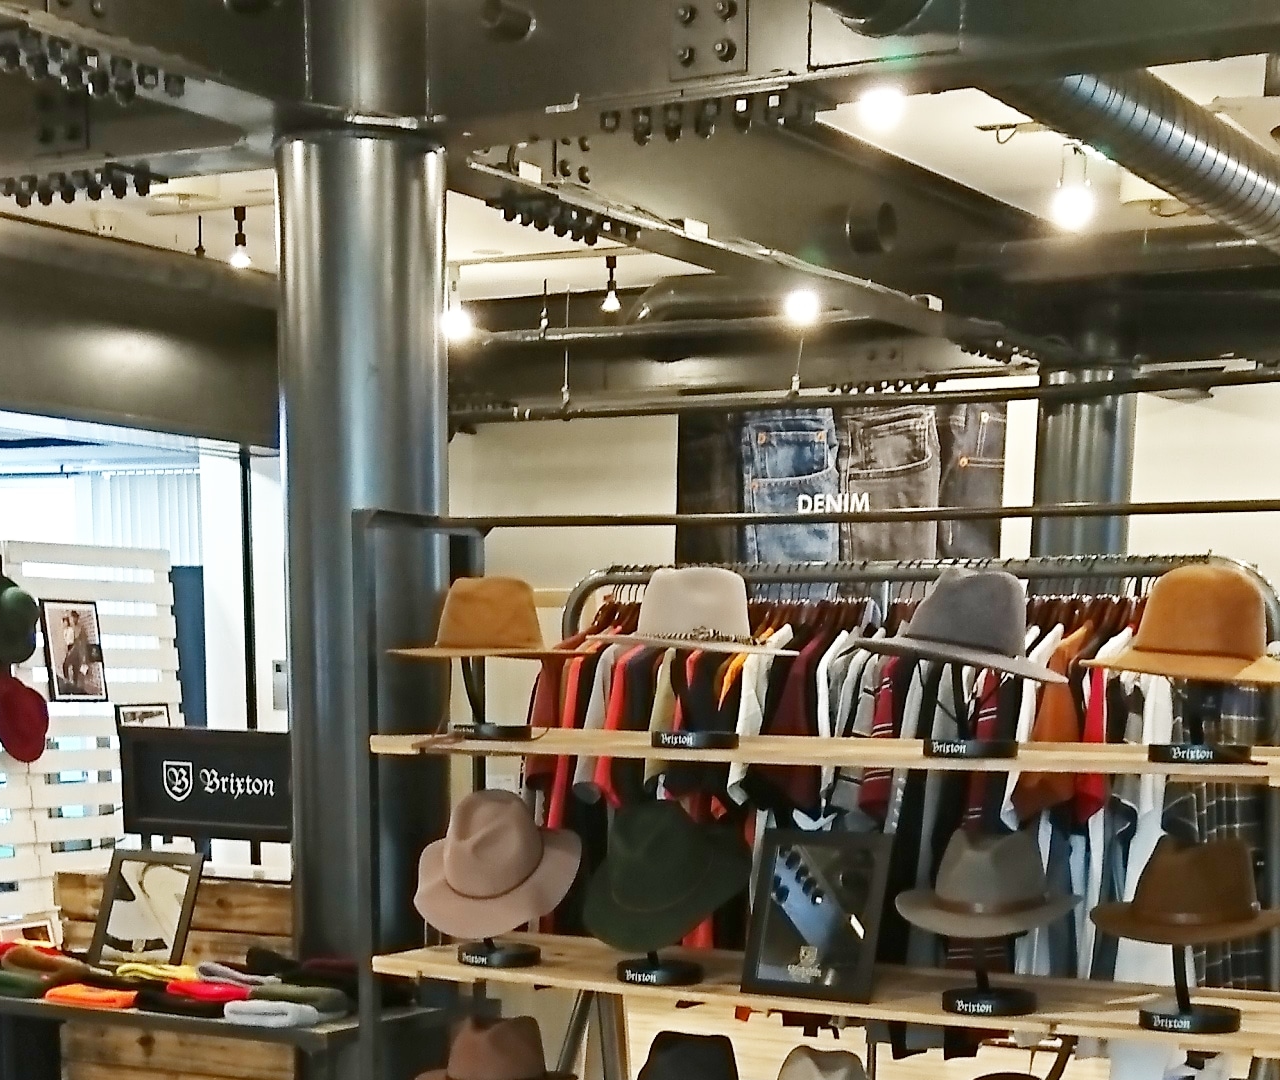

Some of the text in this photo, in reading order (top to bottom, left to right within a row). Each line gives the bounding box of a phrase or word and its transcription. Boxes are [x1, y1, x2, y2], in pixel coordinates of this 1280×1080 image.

[797, 491, 870, 514] DENIM
[660, 733, 694, 746] Brixton
[931, 740, 967, 754] Brixton
[1171, 746, 1214, 762] Brixton
[199, 768, 276, 800] Brixton
[625, 969, 658, 984] Brixton
[954, 999, 994, 1013] Brixton
[1151, 1015, 1191, 1030] Brixton
